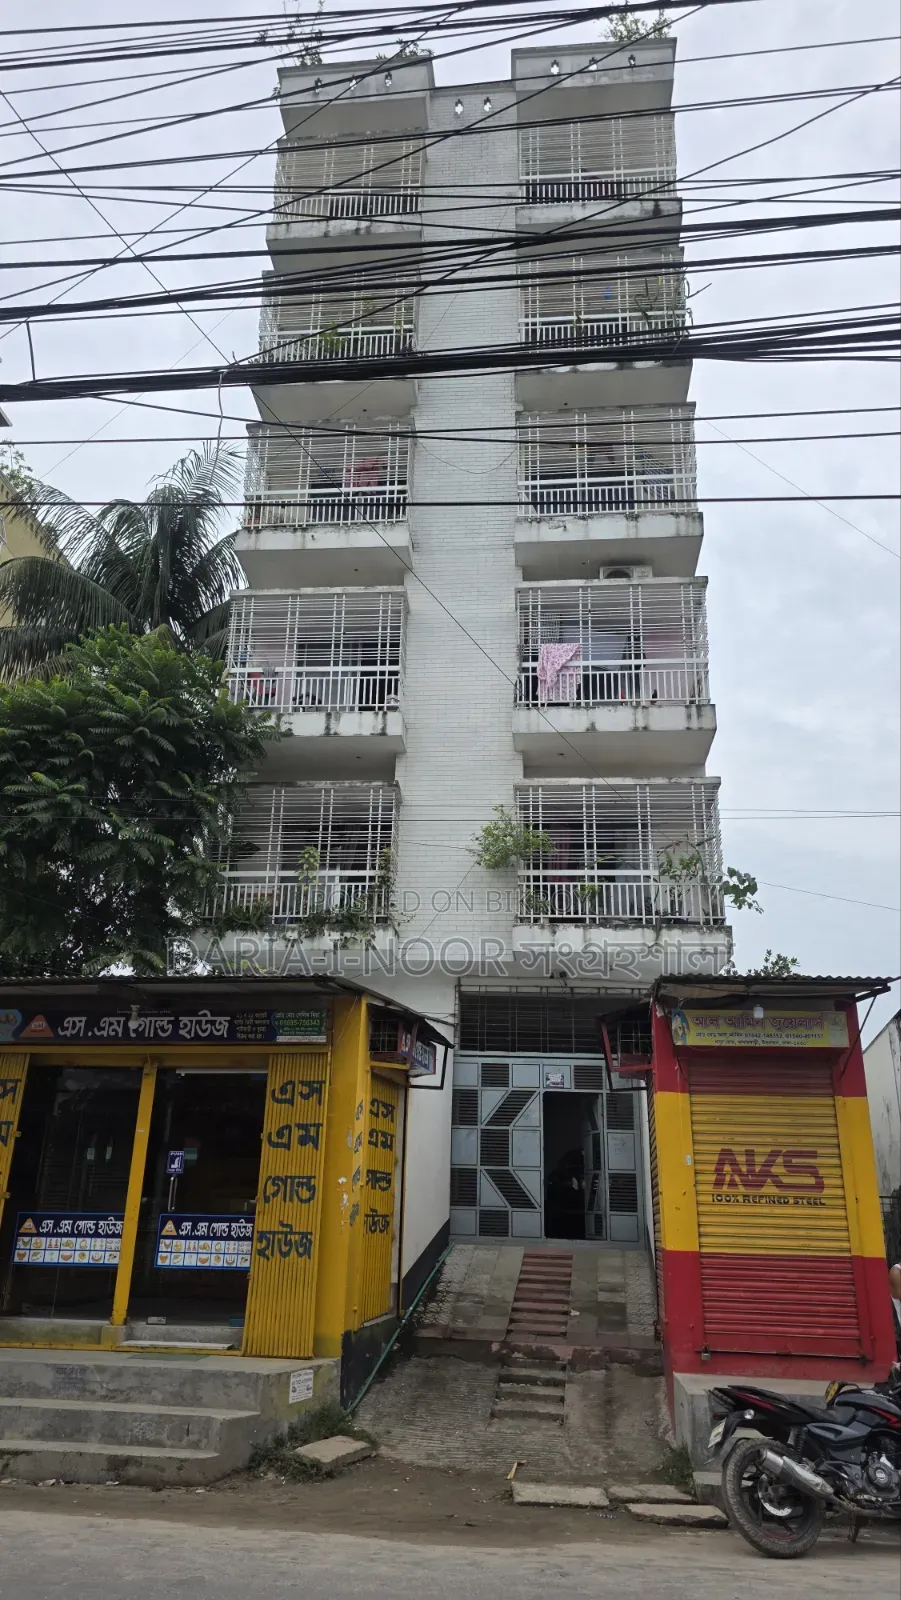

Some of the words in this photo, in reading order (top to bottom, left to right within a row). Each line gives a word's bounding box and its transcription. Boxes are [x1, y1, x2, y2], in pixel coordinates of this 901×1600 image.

[179, 1009, 231, 1039] হাউজ
[271, 1079, 325, 1107] এস
[369, 1097, 396, 1123] এস
[268, 1122, 323, 1151] এম
[368, 1128, 395, 1152] এম
[712, 1147, 825, 1194] AKS
[263, 1175, 317, 1204] গোল্ড
[712, 1194, 740, 1204] 100%
[742, 1195, 791, 1205] REFINED
[792, 1197, 826, 1206] STEEL
[74, 1219, 97, 1234] গোল্ড
[98, 1216, 124, 1236] হাউজ
[210, 1222, 230, 1237] গোল্ড
[231, 1218, 254, 1239] হাউজ
[257, 1219, 313, 1262] হাউজ
